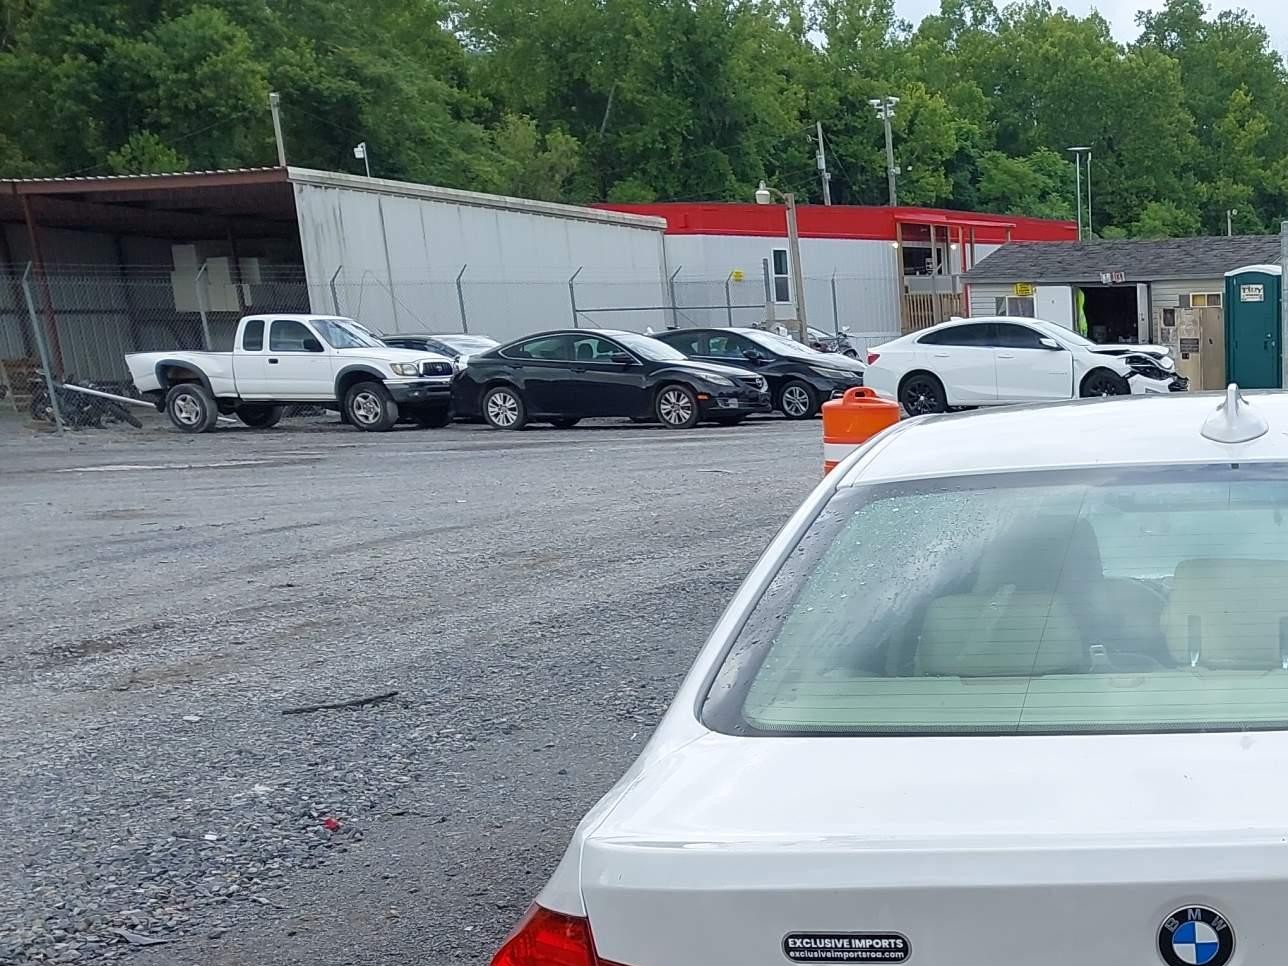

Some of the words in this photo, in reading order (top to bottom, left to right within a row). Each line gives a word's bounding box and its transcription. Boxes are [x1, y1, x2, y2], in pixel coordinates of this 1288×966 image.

[1164, 908, 1227, 933] BMW
[788, 938, 850, 948] EXCLUSIVE
[852, 938, 904, 948] IMPORTS
[789, 949, 905, 960] exclusiveimportsroa.com
